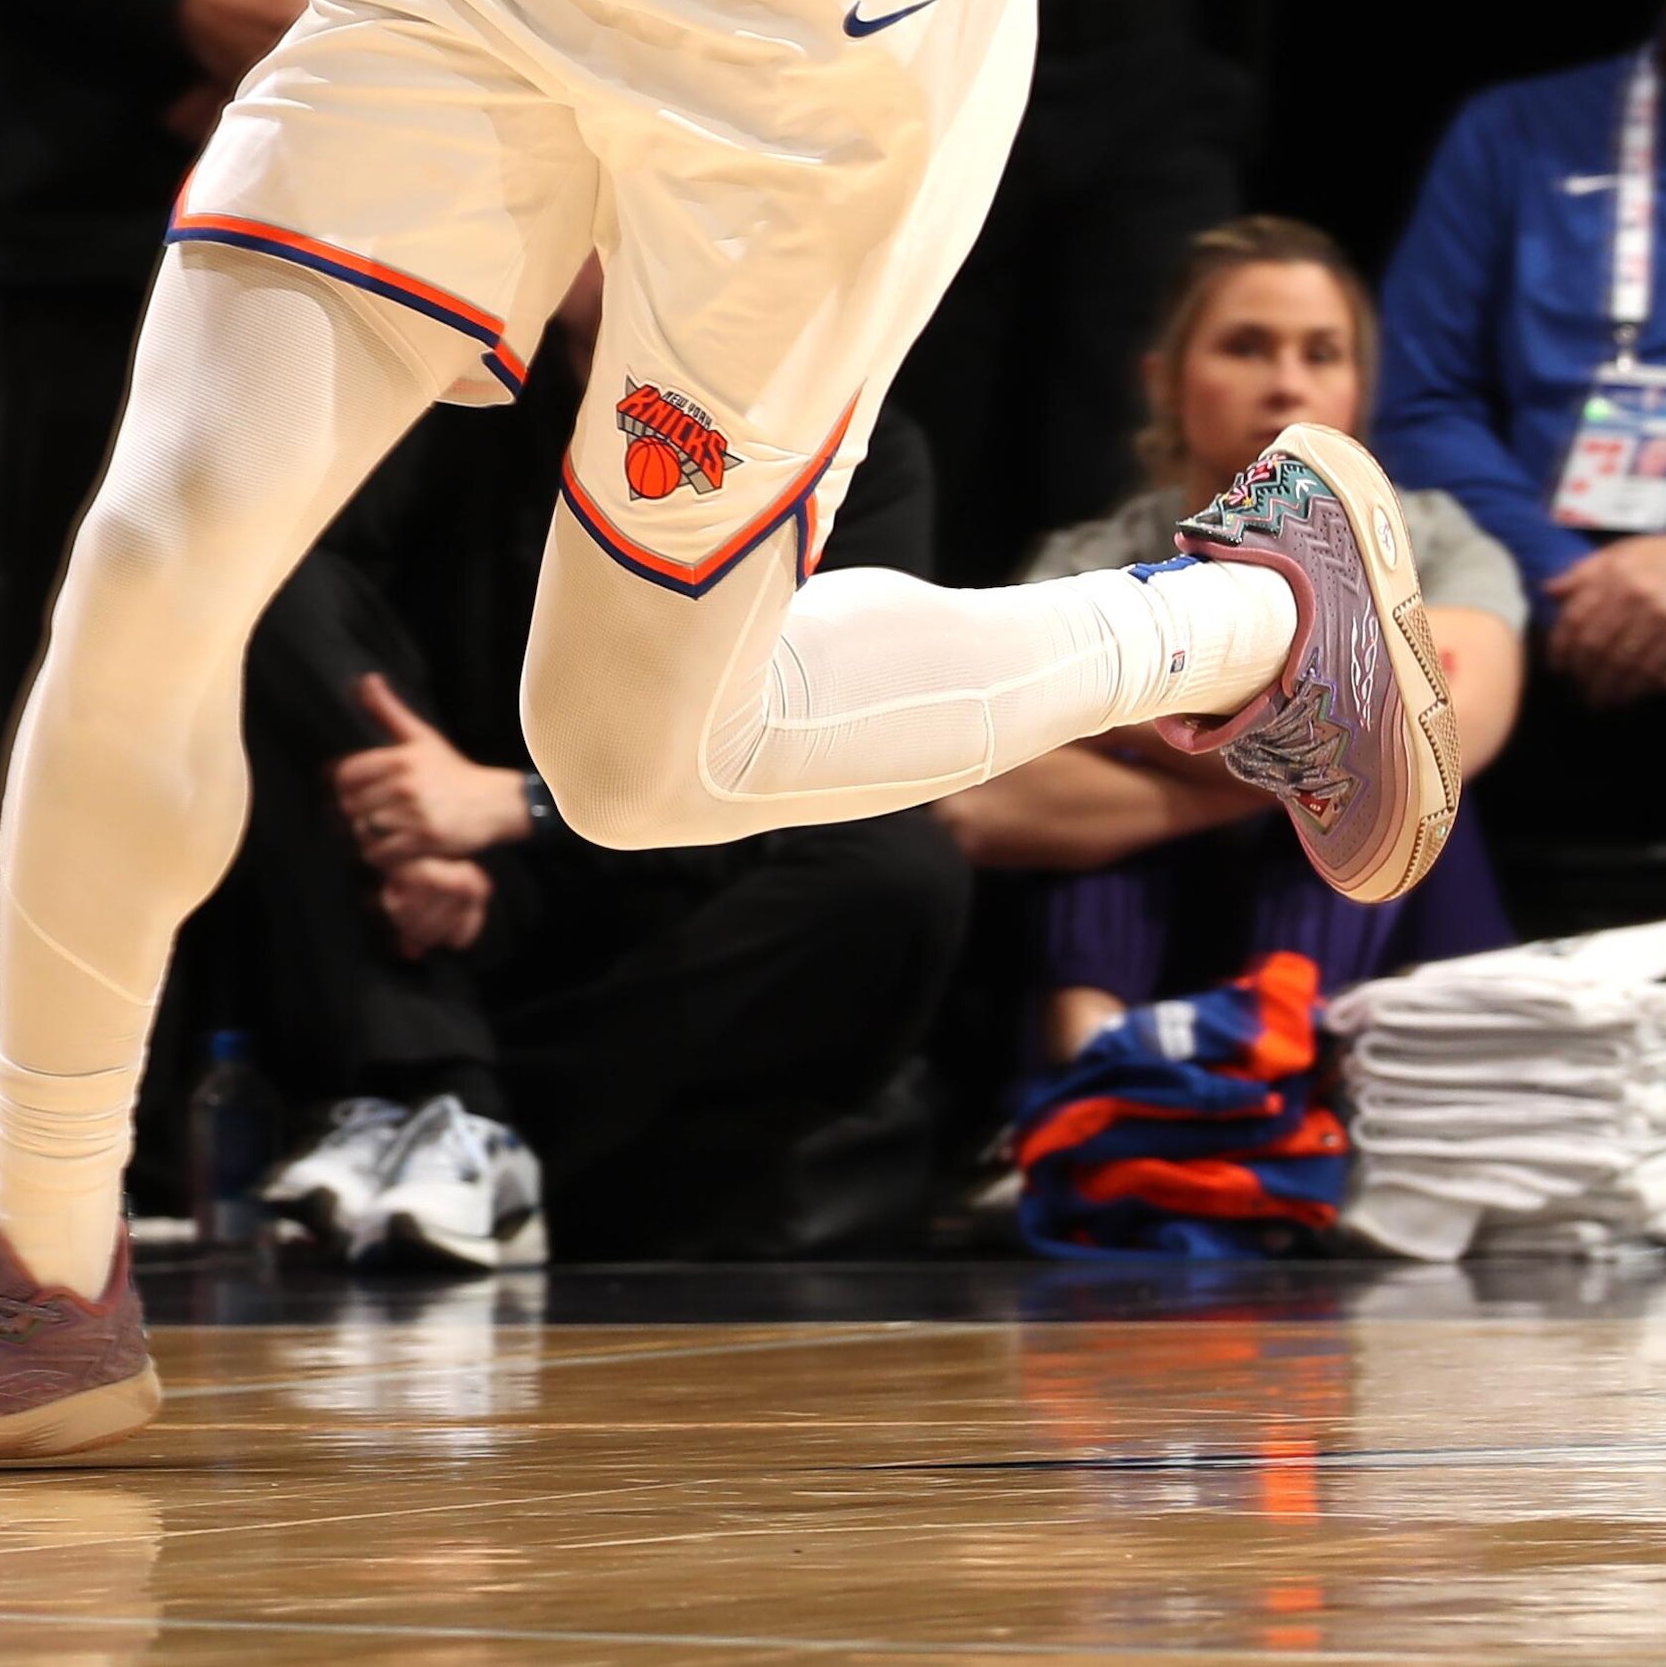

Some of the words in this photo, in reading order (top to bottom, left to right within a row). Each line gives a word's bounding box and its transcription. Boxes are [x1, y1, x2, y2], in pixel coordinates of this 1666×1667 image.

[616, 384, 728, 489] KNICKS
[662, 391, 688, 408] NEW
[688, 402, 713, 430] YORK
